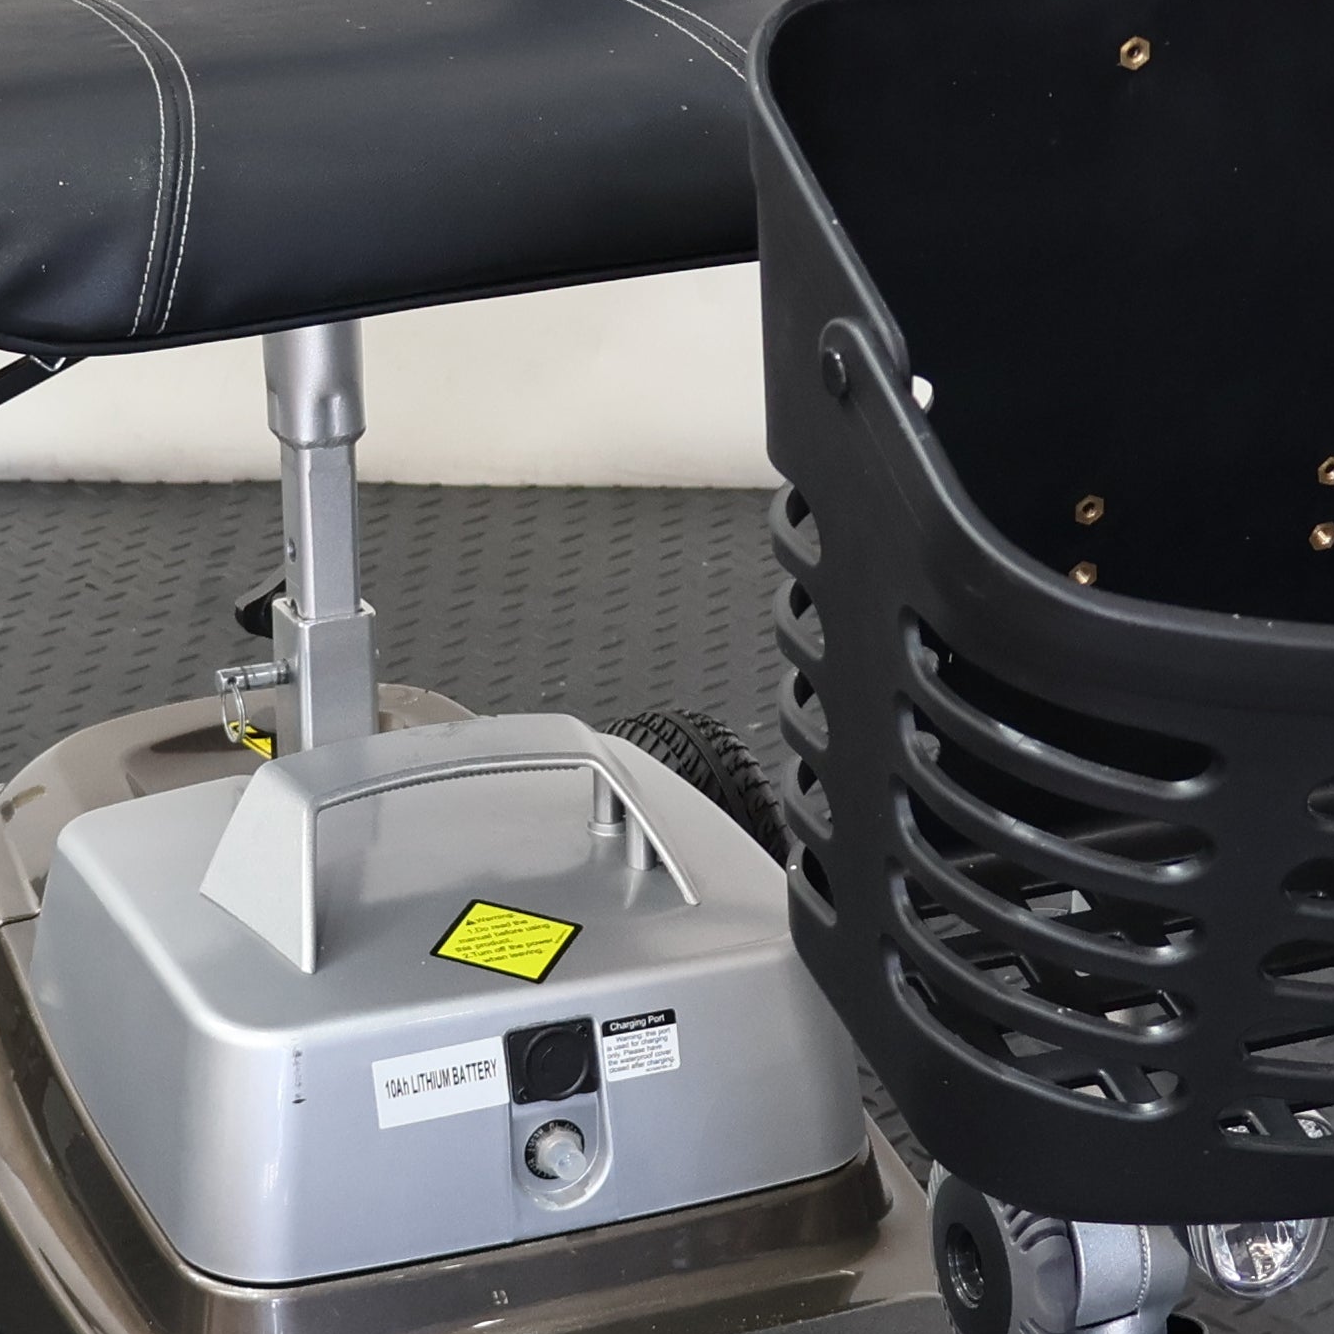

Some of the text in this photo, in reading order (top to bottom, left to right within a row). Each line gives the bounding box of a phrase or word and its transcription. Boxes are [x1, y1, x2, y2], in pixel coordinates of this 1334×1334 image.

[610, 1014, 665, 1031] Charging Port
[385, 1059, 497, 1099] 10Ah LITHIUM BATTERY
